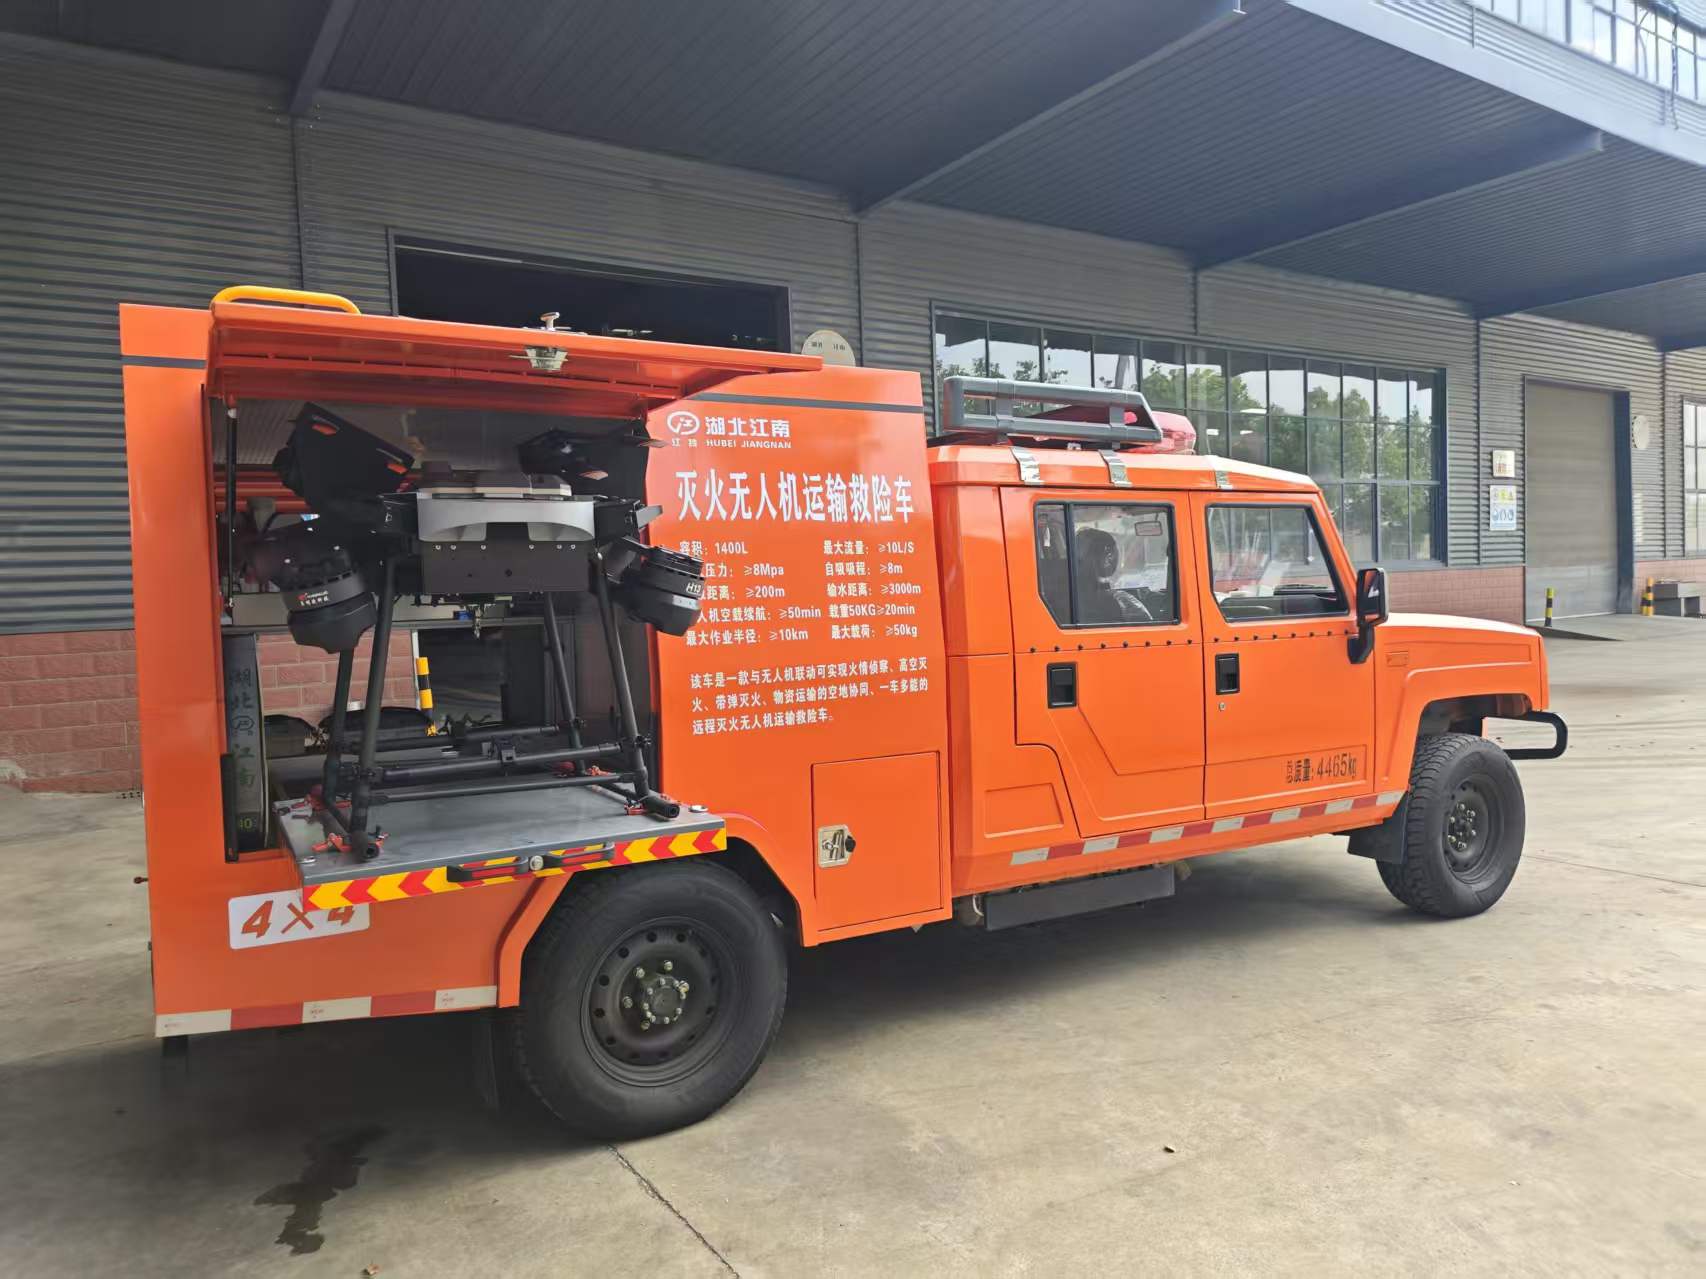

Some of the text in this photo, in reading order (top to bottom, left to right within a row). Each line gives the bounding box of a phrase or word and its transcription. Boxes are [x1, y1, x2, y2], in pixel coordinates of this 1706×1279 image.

[705, 416, 791, 438] 湖北江南
[706, 439, 792, 449] HUBEI JIANGNAN
[675, 469, 914, 524] 灭火无人机运输救险车
[715, 541, 748, 555] 1400L
[823, 540, 914, 556] 最大流量： ≥10L/S
[744, 564, 784, 578] ≥8Mpa
[879, 563, 903, 575] ≥8m
[745, 586, 785, 598] ≥200m
[826, 583, 922, 598] 输水距离： ≥3000m
[779, 606, 822, 620] ≥50min
[769, 628, 809, 642] ≥10km
[885, 625, 918, 639] ≥50kg
